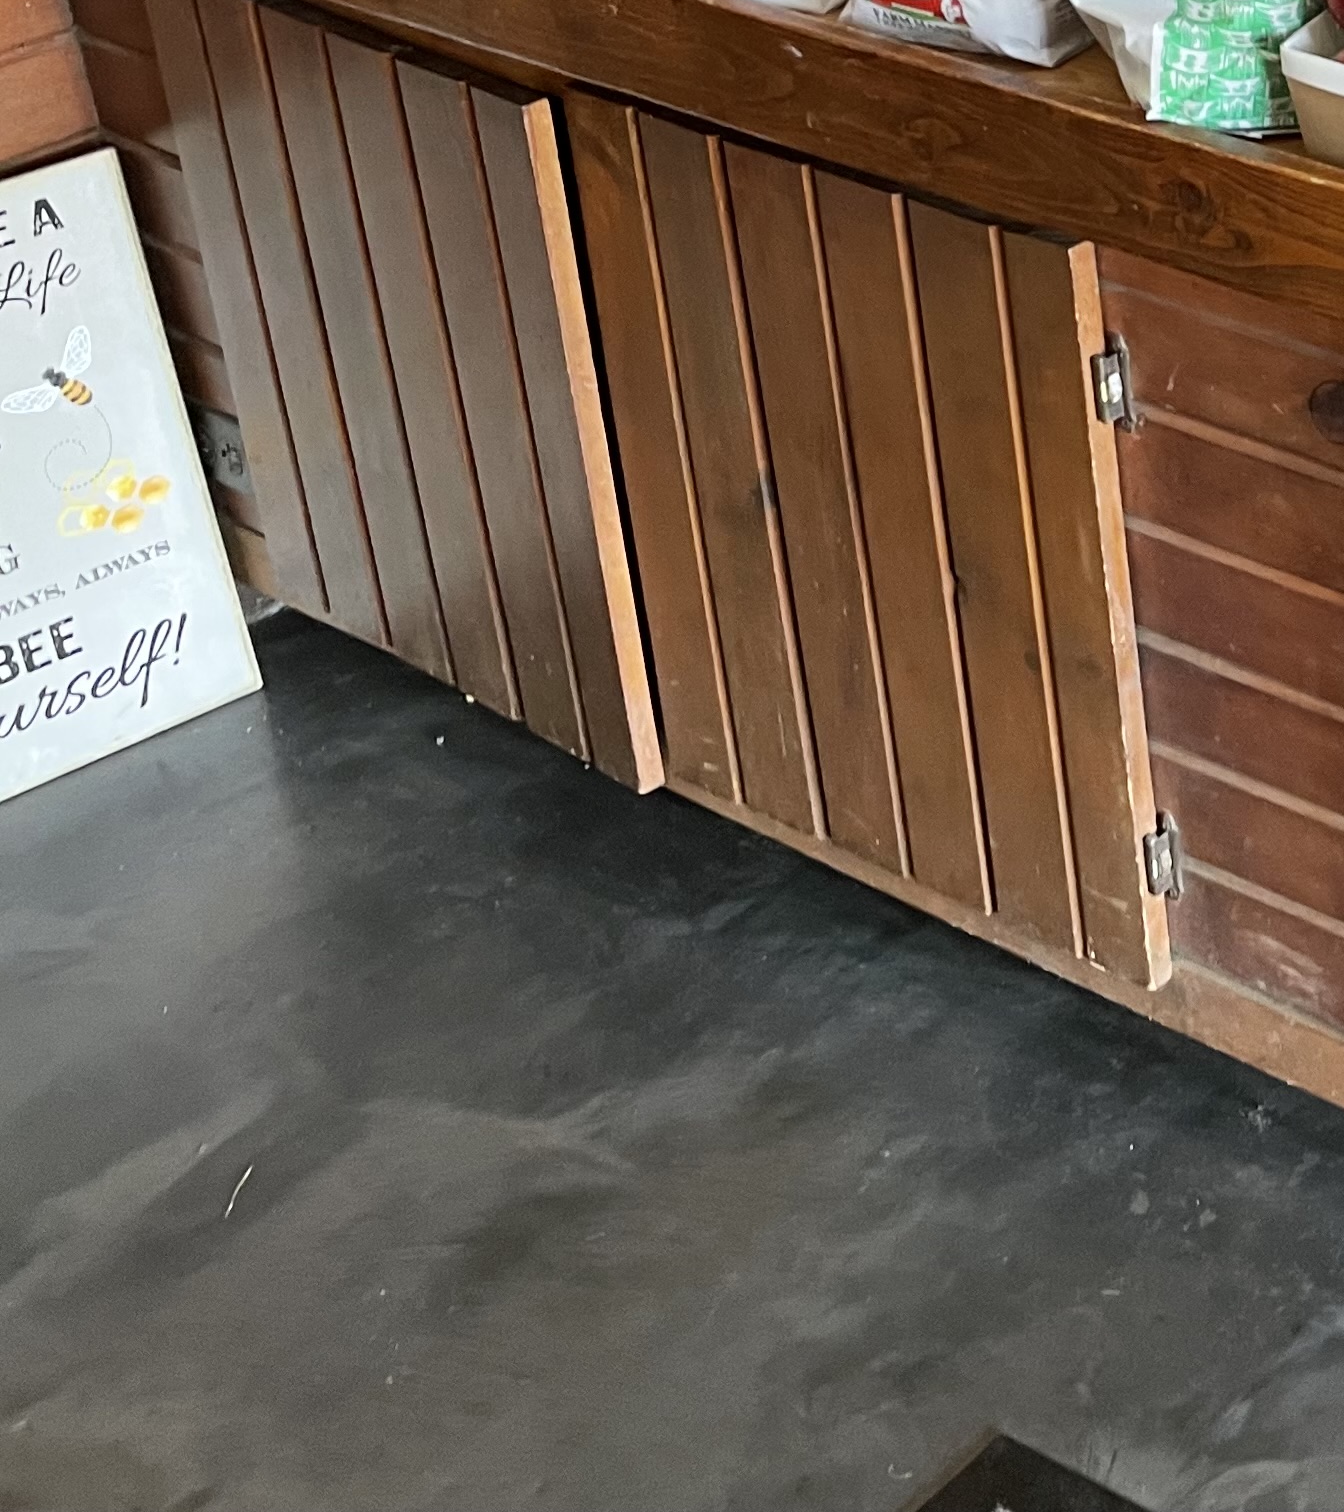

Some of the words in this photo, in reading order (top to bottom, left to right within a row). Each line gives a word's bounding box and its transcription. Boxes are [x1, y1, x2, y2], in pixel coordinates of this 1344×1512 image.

[33, 198, 64, 237] A
[0, 247, 81, 316] Life
[75, 539, 171, 590] ALWAYS
[0, 615, 83, 685] BEE
[0, 611, 187, 738] urself!
